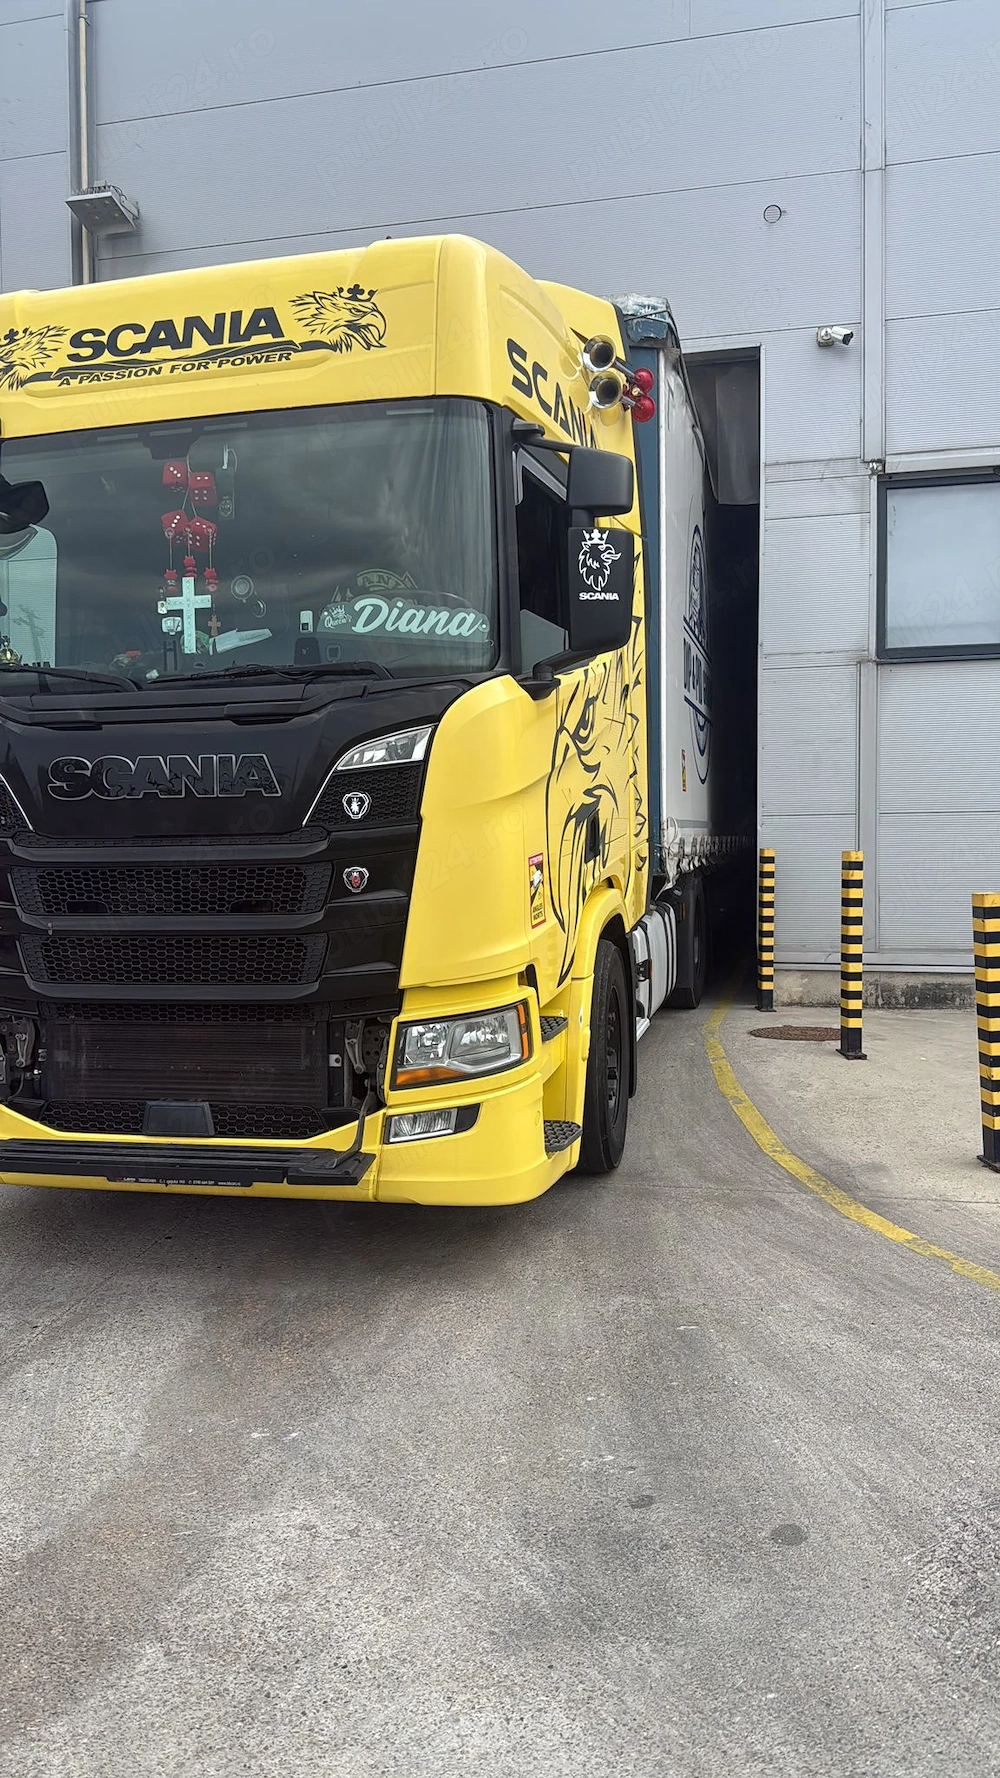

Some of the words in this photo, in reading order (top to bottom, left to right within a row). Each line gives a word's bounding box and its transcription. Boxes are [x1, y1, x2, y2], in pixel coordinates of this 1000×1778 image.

[66, 306, 285, 363] SCANIA
[57, 376, 72, 388] A
[78, 366, 163, 385] PASSION
[169, 361, 209, 374] FOR
[216, 352, 293, 369] POWER
[578, 592, 619, 601] SCANIA
[351, 597, 484, 637] Diana
[46, 753, 283, 800] SCANIA
